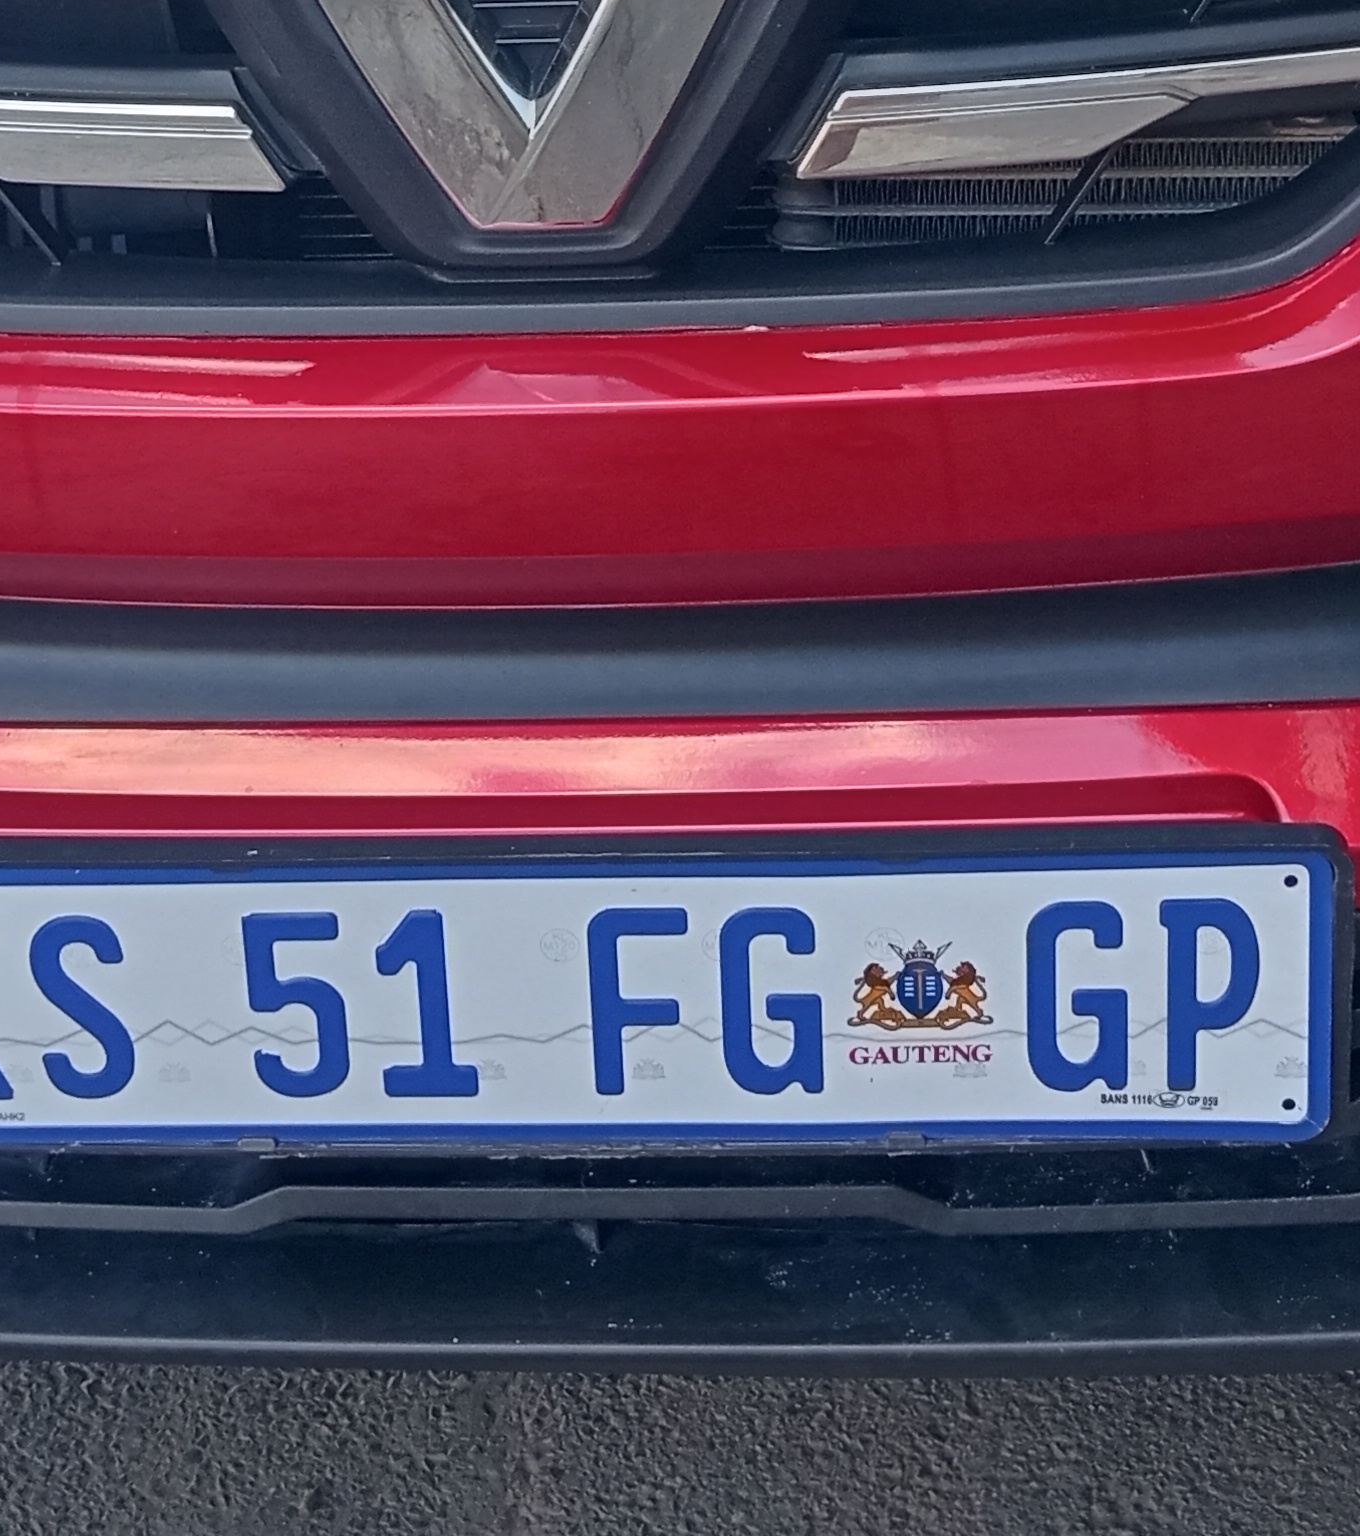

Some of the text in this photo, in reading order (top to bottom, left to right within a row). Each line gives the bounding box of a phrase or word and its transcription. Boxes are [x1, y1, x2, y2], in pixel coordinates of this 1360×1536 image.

[241, 909, 480, 1098] 51
[586, 907, 825, 1095] FG
[1026, 898, 1261, 1092] GP
[848, 1043, 993, 1066] GAUTENG
[1100, 1093, 1129, 1105] SANS
[1187, 1095, 1201, 1105] GP
